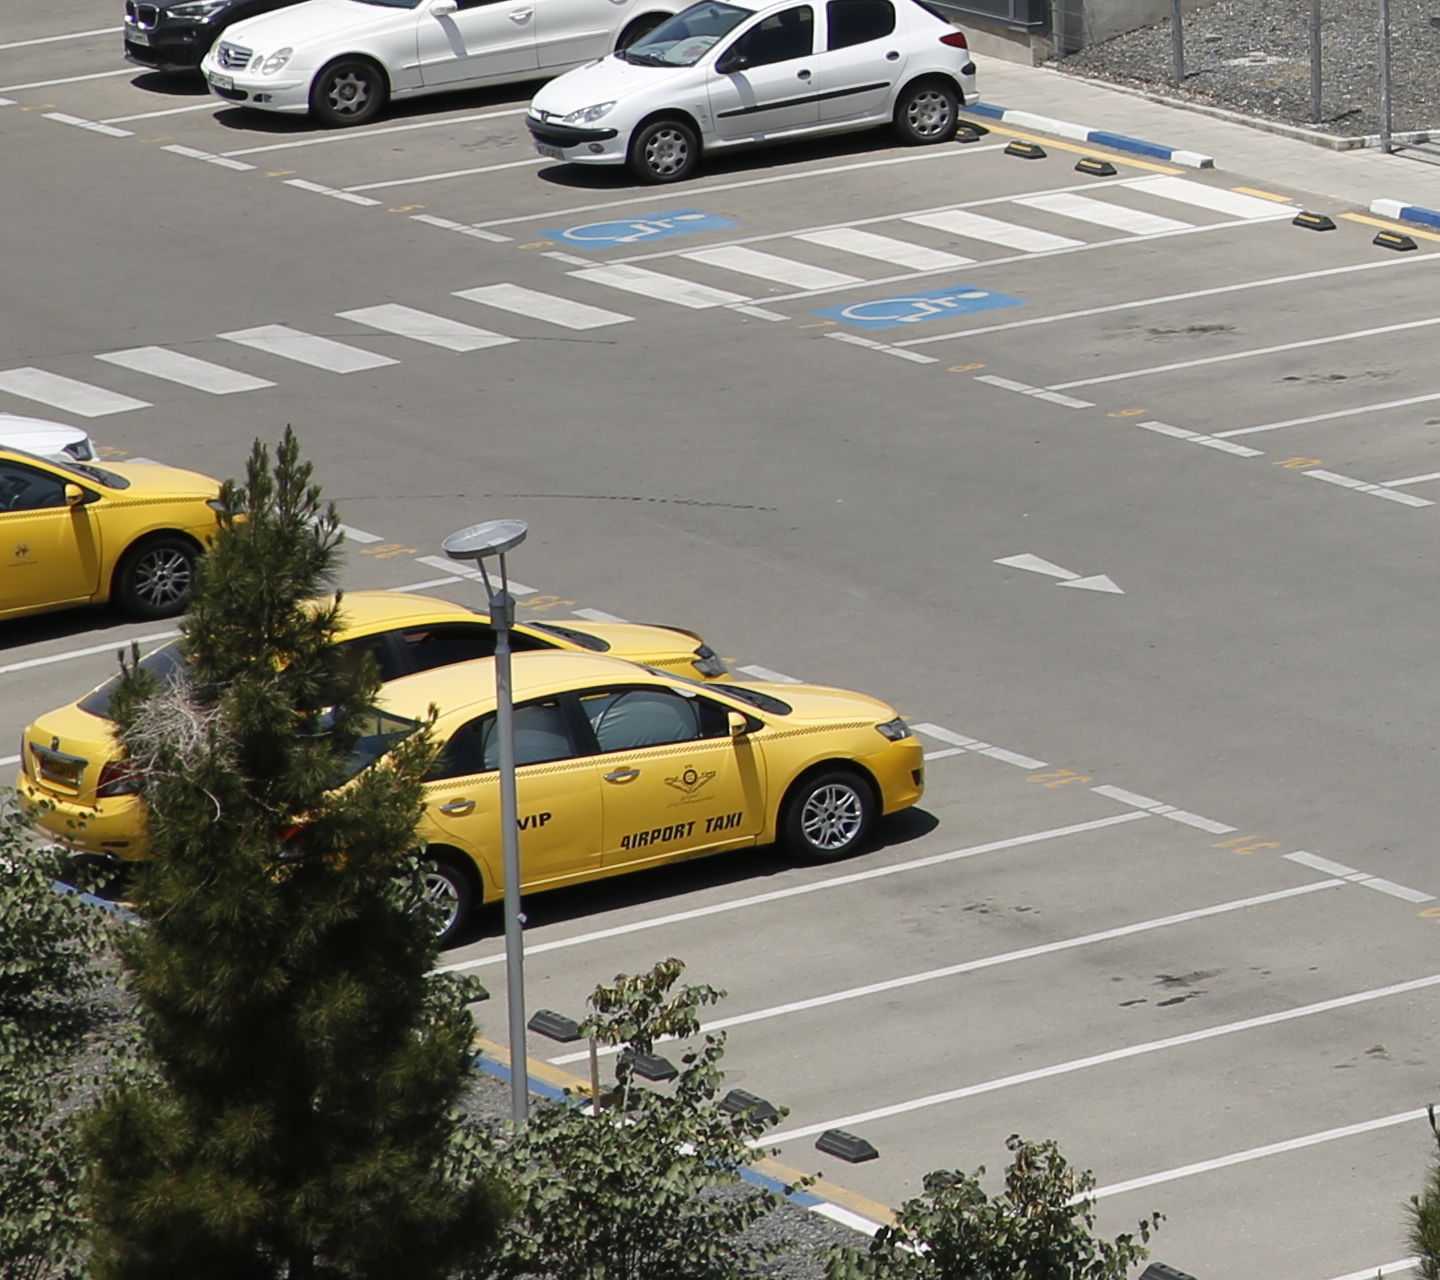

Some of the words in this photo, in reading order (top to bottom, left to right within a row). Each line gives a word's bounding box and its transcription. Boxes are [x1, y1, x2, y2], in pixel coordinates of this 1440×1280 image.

[1108, 408, 1147, 418] 9
[1275, 456, 1323, 469] 10
[360, 543, 418, 559] 36
[1027, 769, 1092, 788] 32
[517, 812, 552, 831] VIP
[620, 820, 696, 850] AIRPORT
[704, 811, 744, 835] TAXI
[1215, 835, 1281, 855] 31
